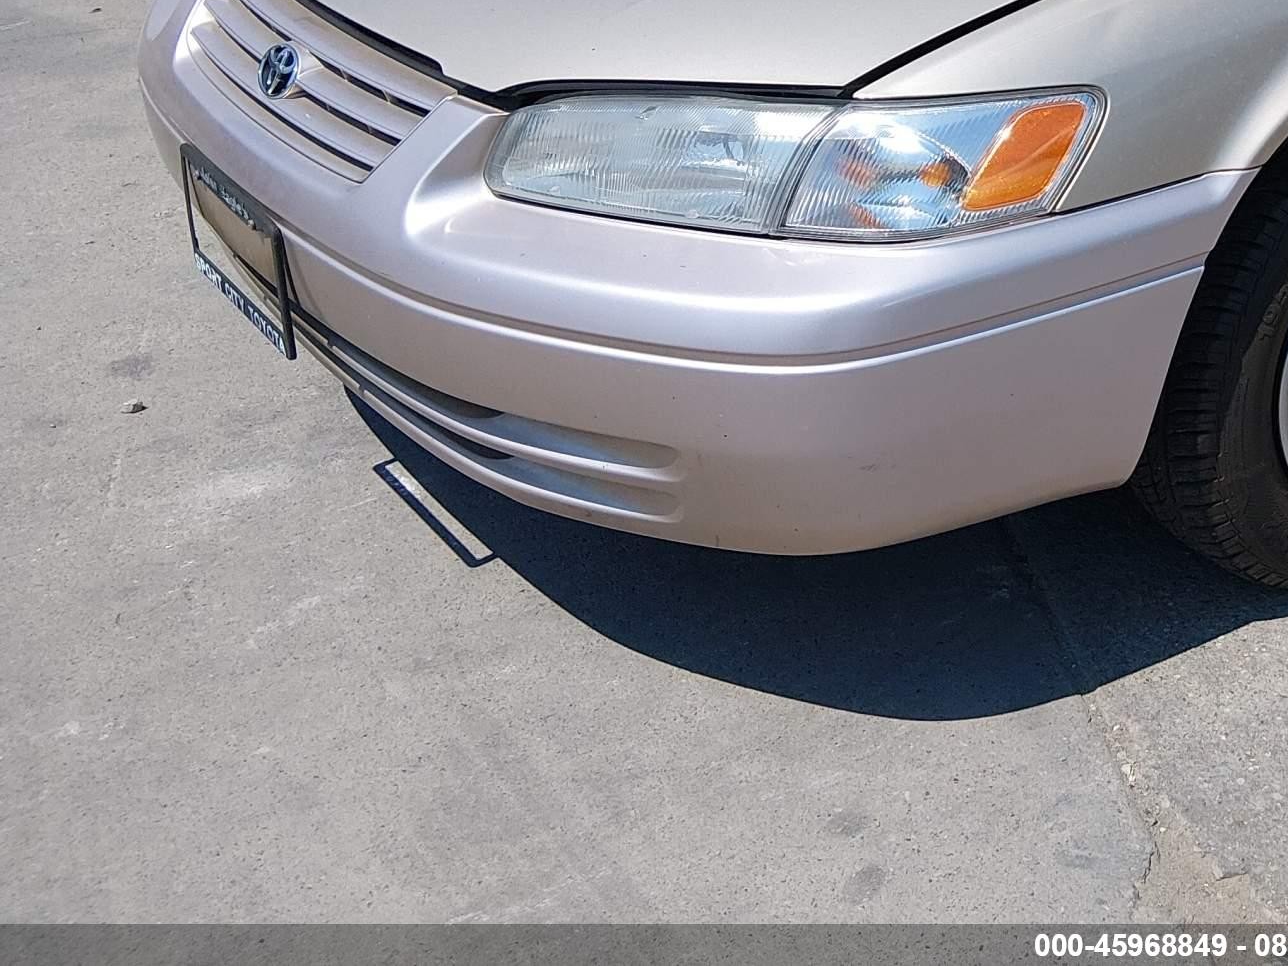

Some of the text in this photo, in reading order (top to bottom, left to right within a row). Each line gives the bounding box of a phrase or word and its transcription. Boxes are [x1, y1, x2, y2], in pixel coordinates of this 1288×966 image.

[194, 253, 286, 356] SPORT CITY TOYOTA
